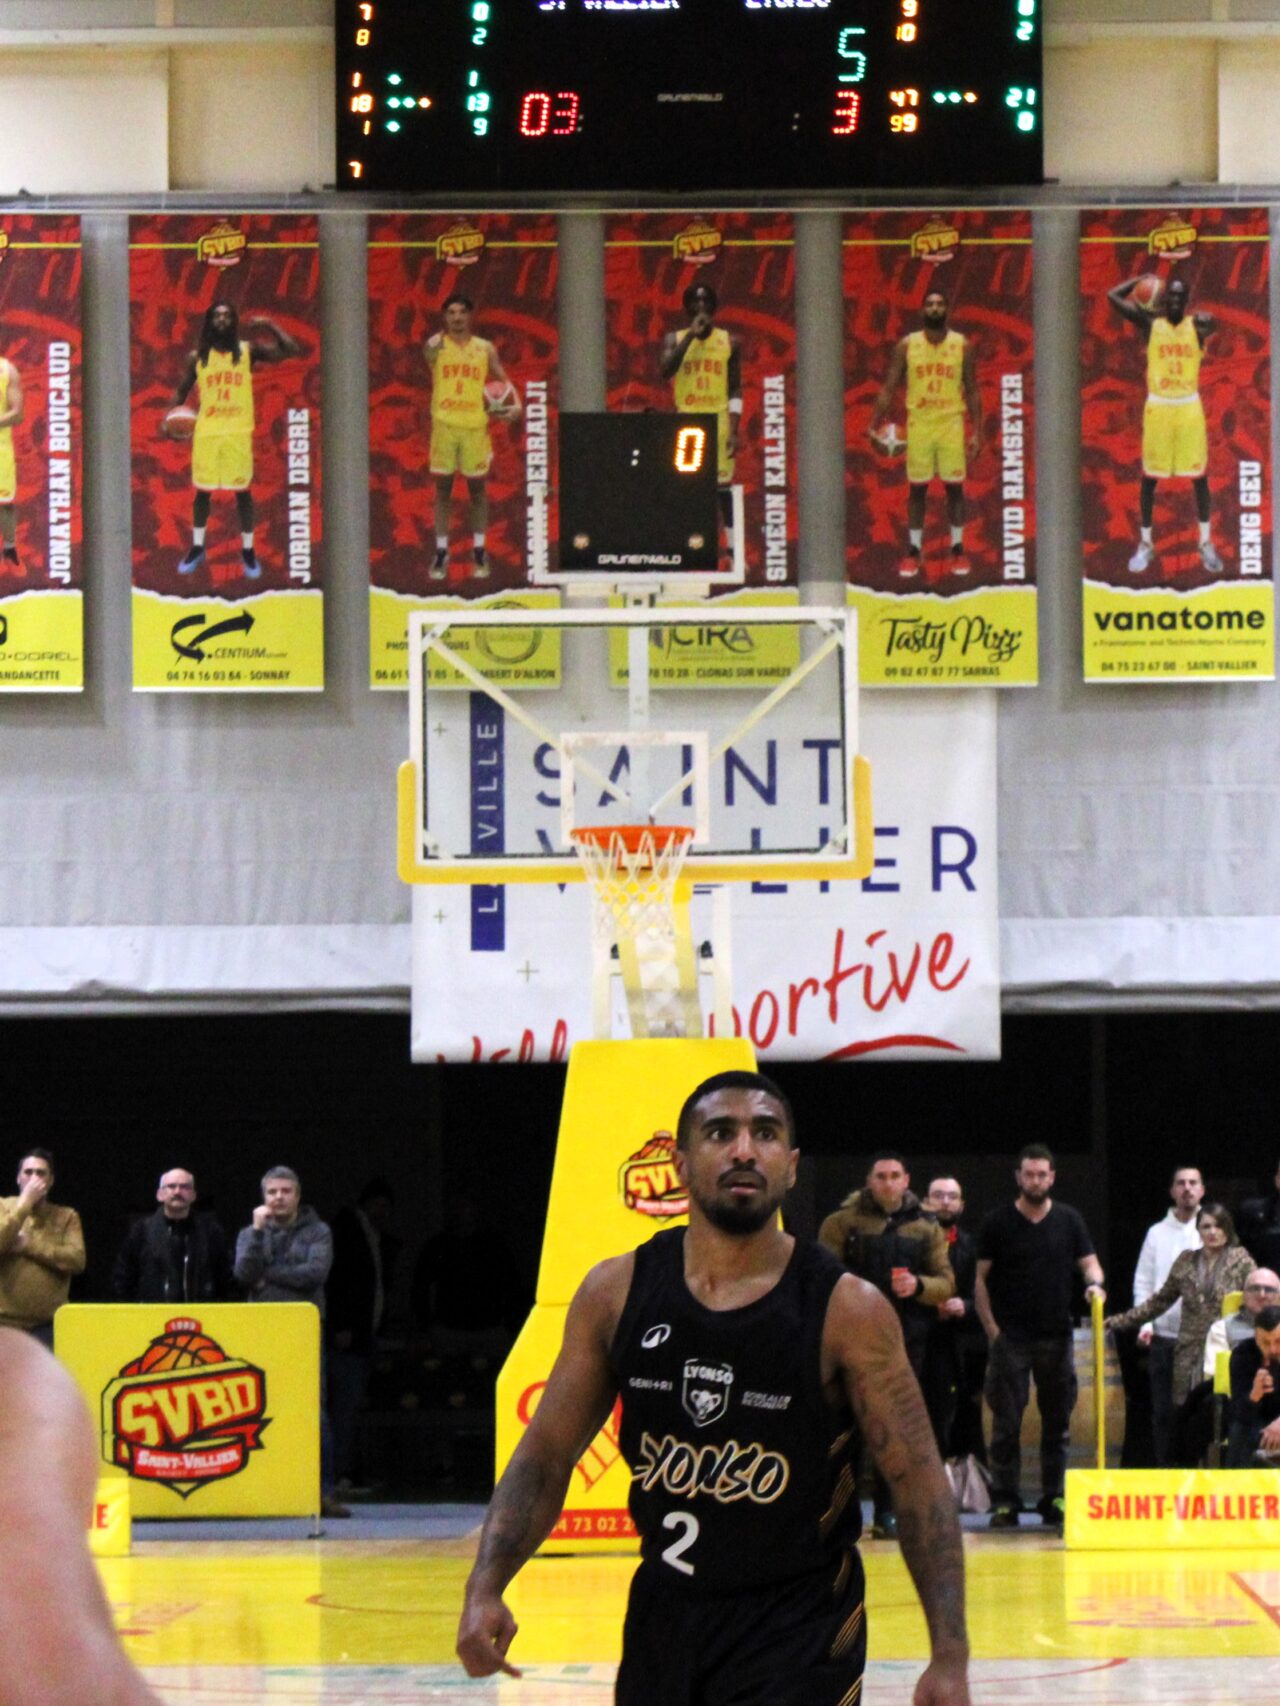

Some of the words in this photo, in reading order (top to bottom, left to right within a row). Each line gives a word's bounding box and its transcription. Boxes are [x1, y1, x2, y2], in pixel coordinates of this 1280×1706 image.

[521, 92, 578, 136] 03
[832, 91, 859, 134] 3
[49, 341, 71, 452] BOUCAUD
[764, 375, 786, 487] KALEMBA
[675, 427, 706, 472] 0
[1002, 373, 1025, 500] RAMSEYER
[1239, 460, 1262, 507] GEU
[49, 459, 71, 584] JONATHAN
[288, 491, 311, 583] JORDAN
[1003, 506, 1025, 579] DAVID
[1240, 513, 1262, 575] DENG
[1094, 607, 1265, 631] vanatome
[477, 724, 498, 840] VILLE
[119, 1375, 257, 1447] SVBD
[1087, 1493, 1280, 1521] SAINT-VALLIER
[661, 1510, 700, 1577] 2
